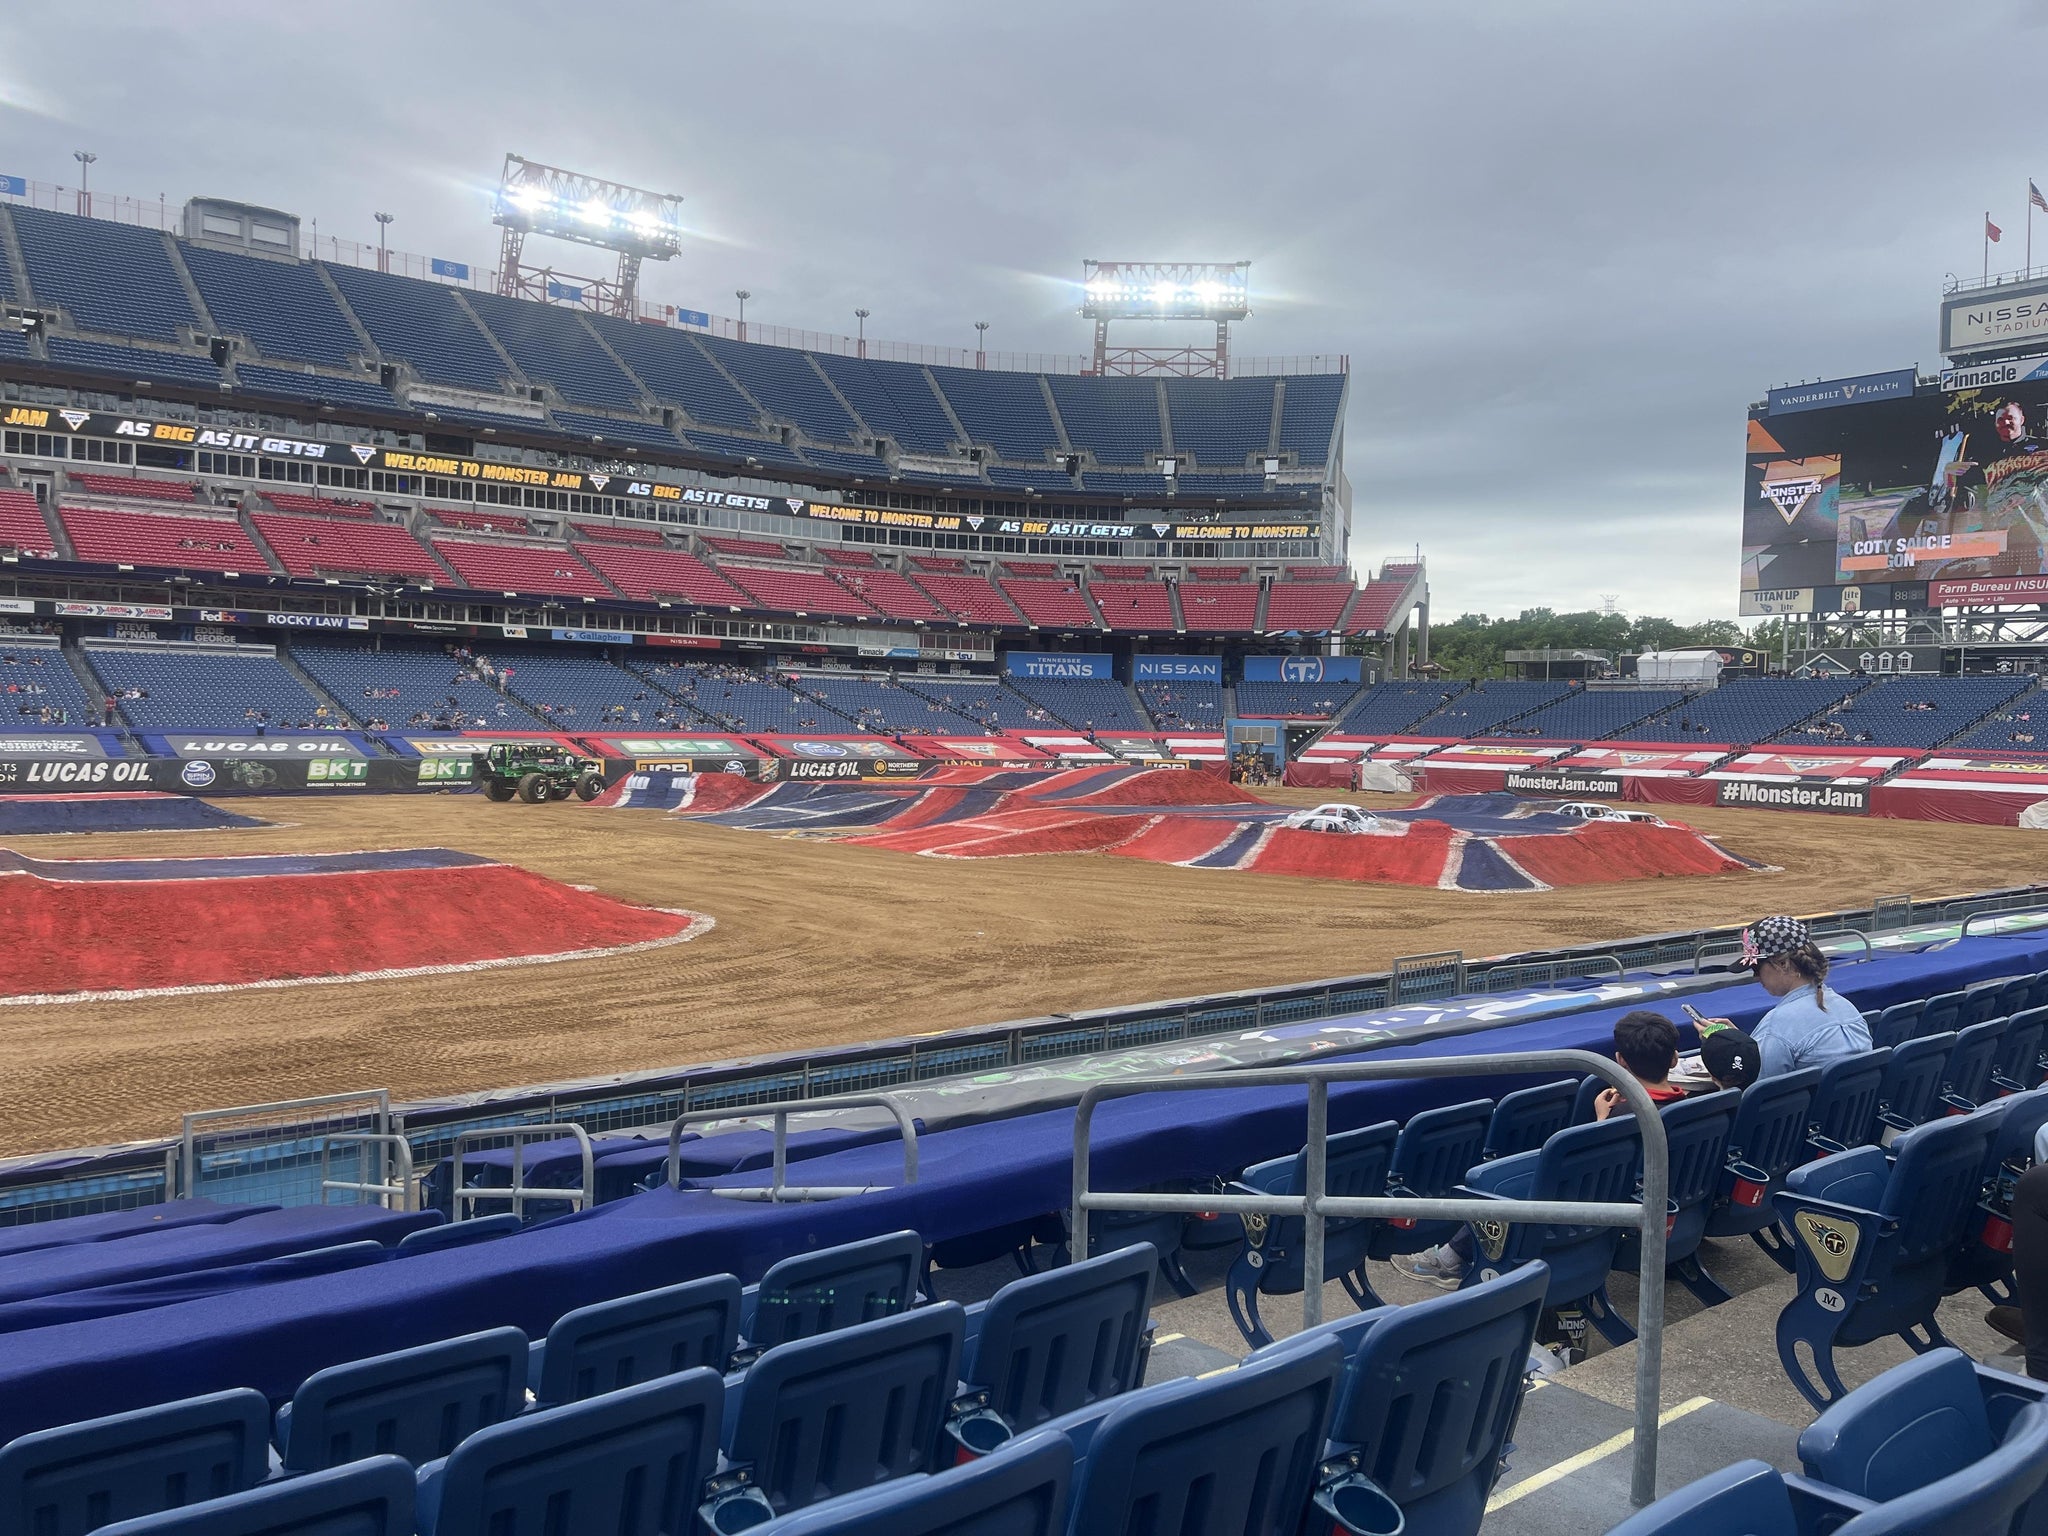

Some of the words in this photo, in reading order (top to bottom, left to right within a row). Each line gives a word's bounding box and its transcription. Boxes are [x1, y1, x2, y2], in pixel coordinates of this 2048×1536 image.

[1943, 366, 2016, 389] Pinnacle
[1781, 390, 1840, 406] VANDERBILT
[1859, 382, 1899, 394] HEALTH
[4, 408, 49, 428] JAM
[116, 421, 151, 437] AS
[154, 424, 196, 442] BIG
[198, 431, 232, 447] AS
[233, 434, 259, 449] IT
[262, 438, 327, 458] GETS!
[384, 452, 459, 475] WELCOME
[462, 462, 480, 477] TO
[482, 464, 549, 486] MONSTER
[551, 473, 582, 489] JAM
[627, 482, 652, 496] AS
[653, 485, 681, 500] BIG
[683, 489, 705, 502] AS
[706, 493, 725, 503] IT
[726, 494, 770, 510] GETS!
[1760, 484, 1822, 498] MONSTER
[1775, 495, 1805, 505] JAM
[810, 504, 863, 522] WELCOME
[865, 510, 878, 523] TO
[880, 512, 932, 528] MONSTER
[934, 518, 960, 529] JAM
[1000, 521, 1020, 532] AS
[1022, 522, 1048, 534] BIG
[1050, 524, 1070, 534] AS
[1072, 525, 1090, 535] IT
[1090, 525, 1134, 536] GETS!
[1176, 526, 1233, 538] WELCOME
[1235, 526, 1250, 538] TO
[1252, 526, 1307, 538] MONSTER
[1854, 539, 1892, 555] COTY
[1939, 584, 1967, 593] Farm
[1970, 583, 2011, 592] Bureau
[1754, 591, 1783, 602] TITAN
[1785, 590, 1800, 600] UP
[1844, 590, 1859, 600] Lite
[144, 608, 166, 616] ARROW
[1780, 603, 1794, 612] Lite
[200, 611, 236, 622] FedEx
[268, 614, 313, 626] ROCKY
[316, 617, 343, 628] LAW
[116, 623, 150, 631] STEVE
[194, 626, 224, 635] EDDIE
[194, 634, 236, 643] GEORGE
[579, 632, 622, 642] Gallagher
[860, 648, 884, 656] Pinnacle
[957, 652, 973, 660] tsu
[1026, 663, 1093, 677] TITANS
[1140, 664, 1216, 675] NISSAN
[184, 742, 289, 752] LUCAS
[626, 742, 724, 751] BKT
[26, 762, 108, 782] LUCAS
[308, 763, 367, 776] BKT
[419, 762, 472, 775] BKT
[790, 762, 837, 777] LUCAS
[1507, 775, 1618, 793] MonsterJam.com
[1722, 783, 1863, 808] #MonsterJam
[1252, 1255, 1258, 1264] K
[1822, 1293, 1838, 1307] M
